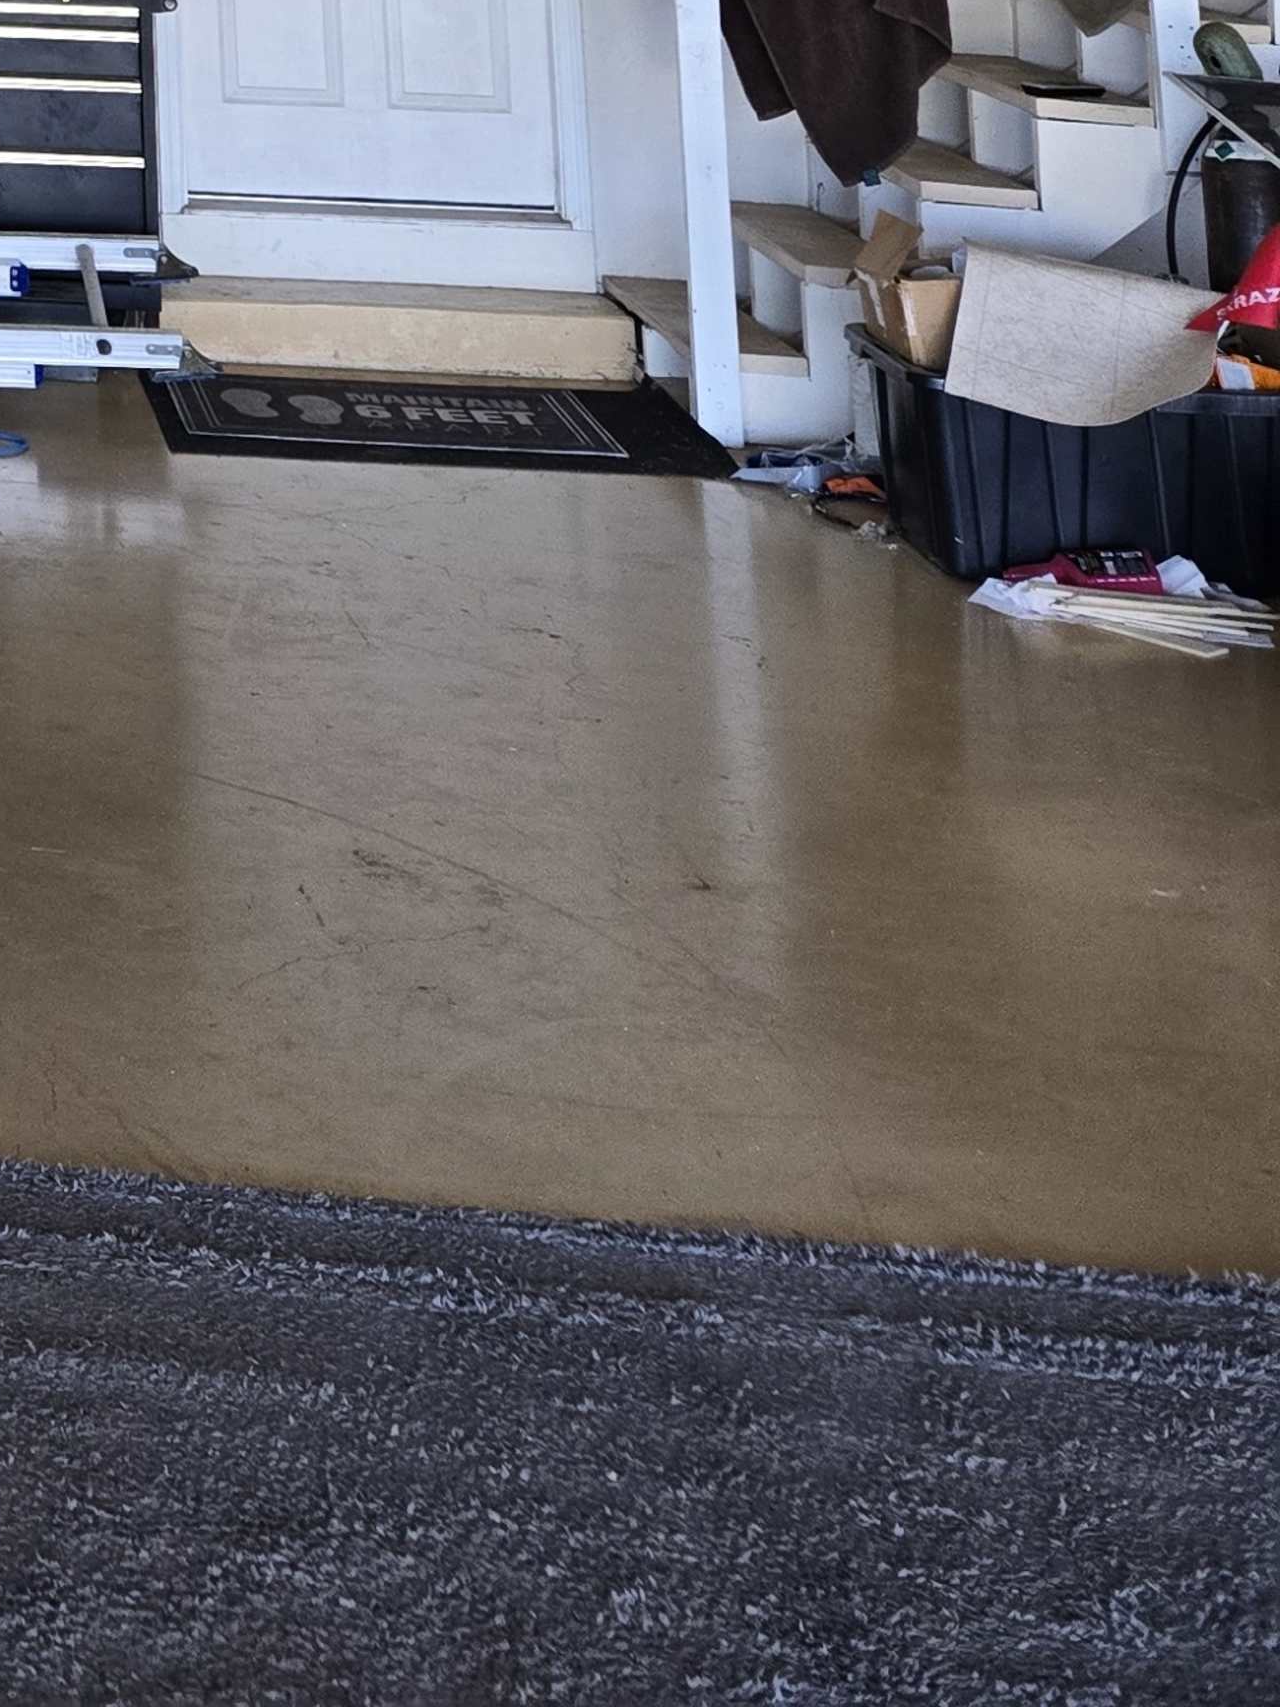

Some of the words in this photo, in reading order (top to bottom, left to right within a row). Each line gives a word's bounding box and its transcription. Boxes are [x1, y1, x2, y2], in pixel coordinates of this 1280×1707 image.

[344, 392, 529, 410] MAINTAIN
[354, 404, 392, 419] 6
[401, 406, 535, 426] FEET
[368, 419, 544, 436] APART
